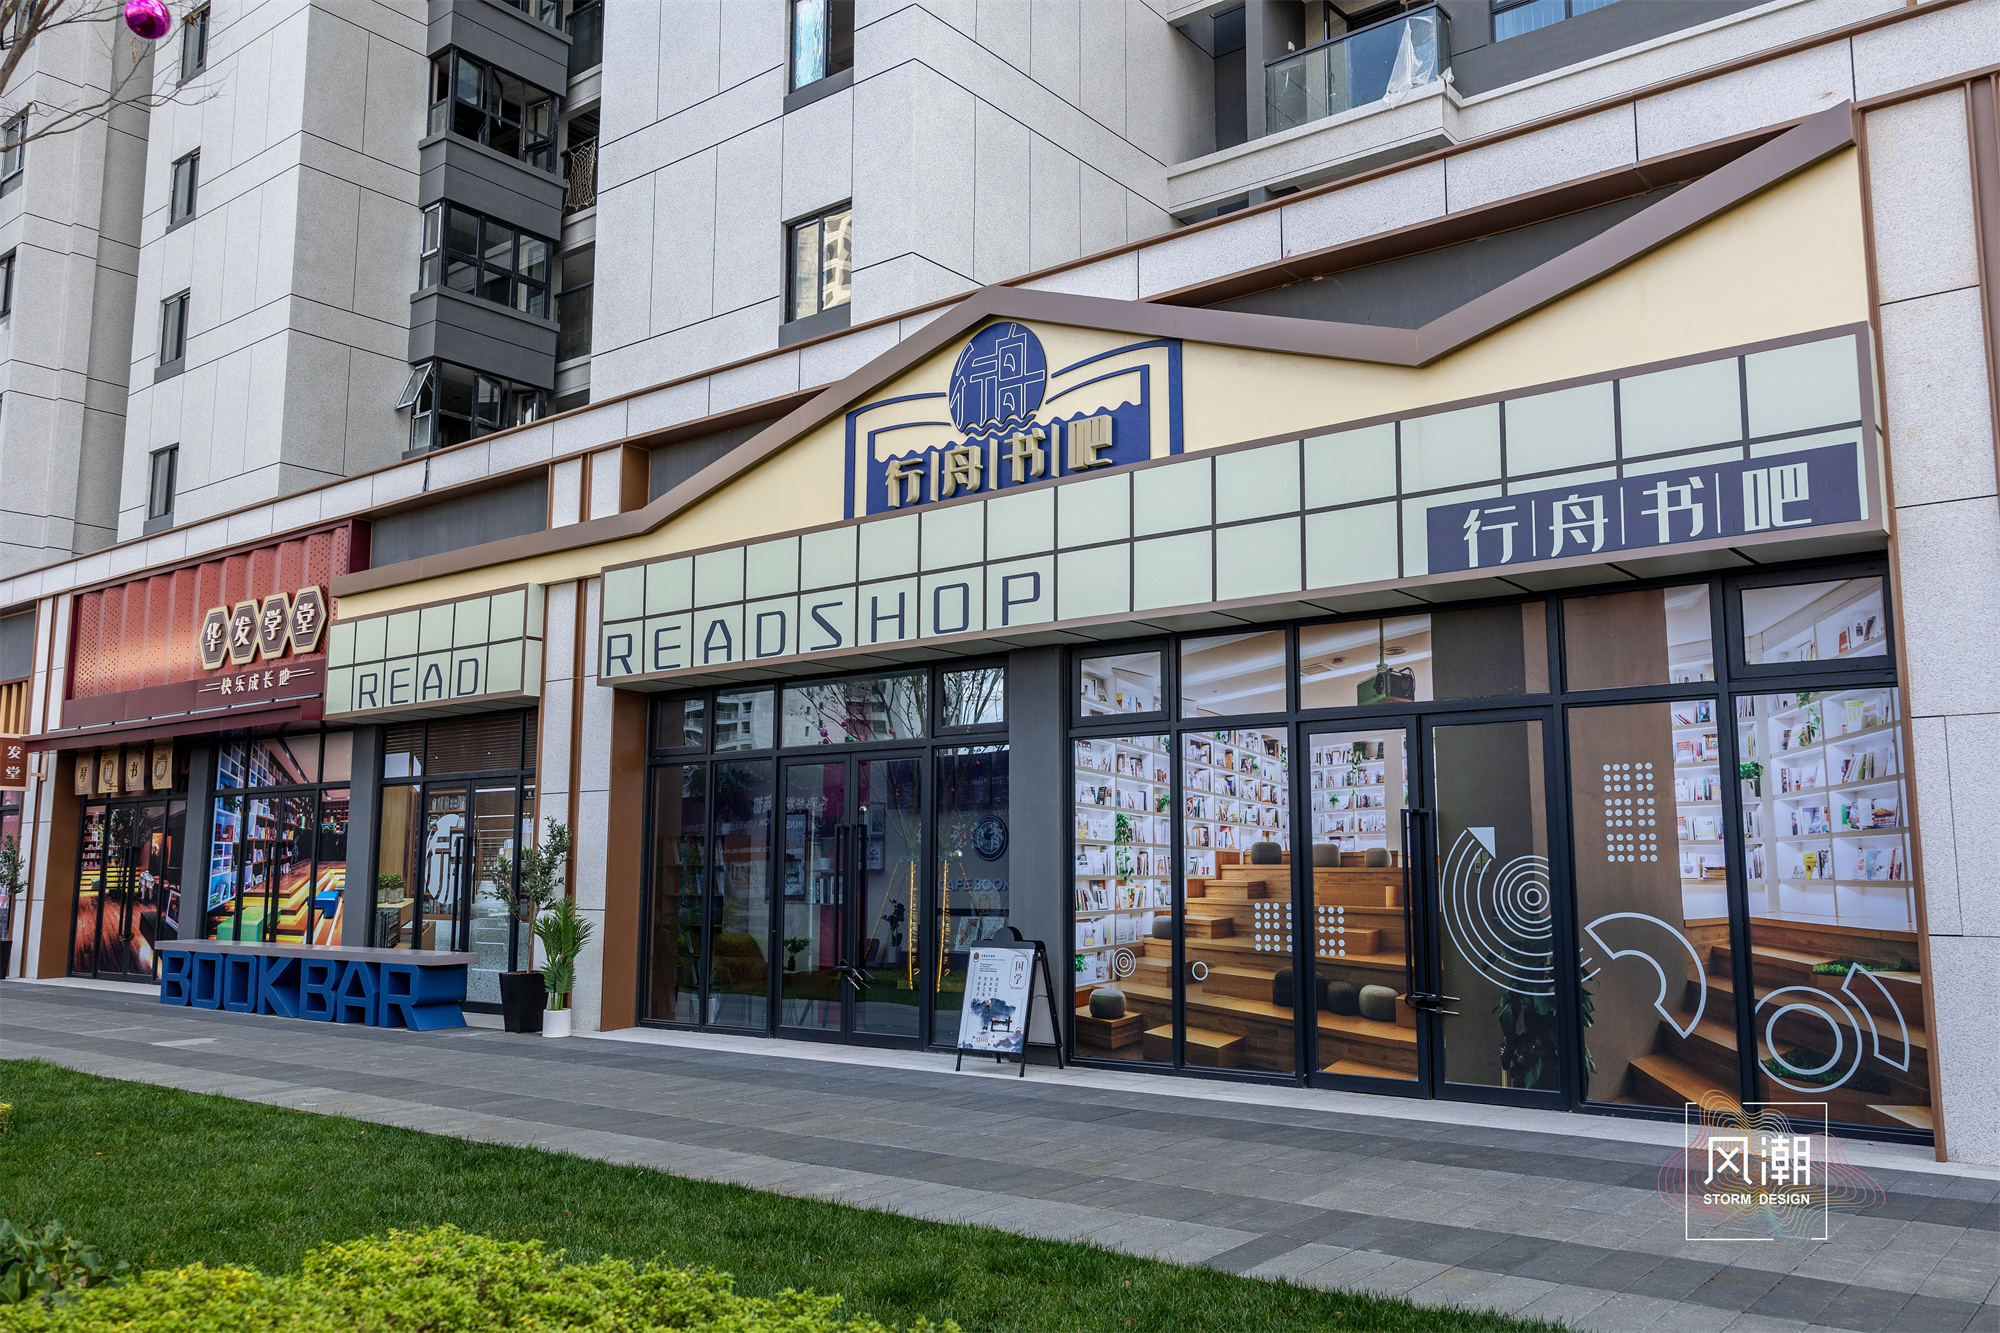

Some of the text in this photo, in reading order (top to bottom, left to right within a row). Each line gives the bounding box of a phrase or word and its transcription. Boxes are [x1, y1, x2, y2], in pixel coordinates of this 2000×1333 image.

[205, 603, 315, 652] 华发学堂
[605, 570, 1042, 678] READSHOP
[220, 668, 291, 695] 快乐成长地
[357, 657, 480, 711] READ
[130, 762, 139, 778] 书
